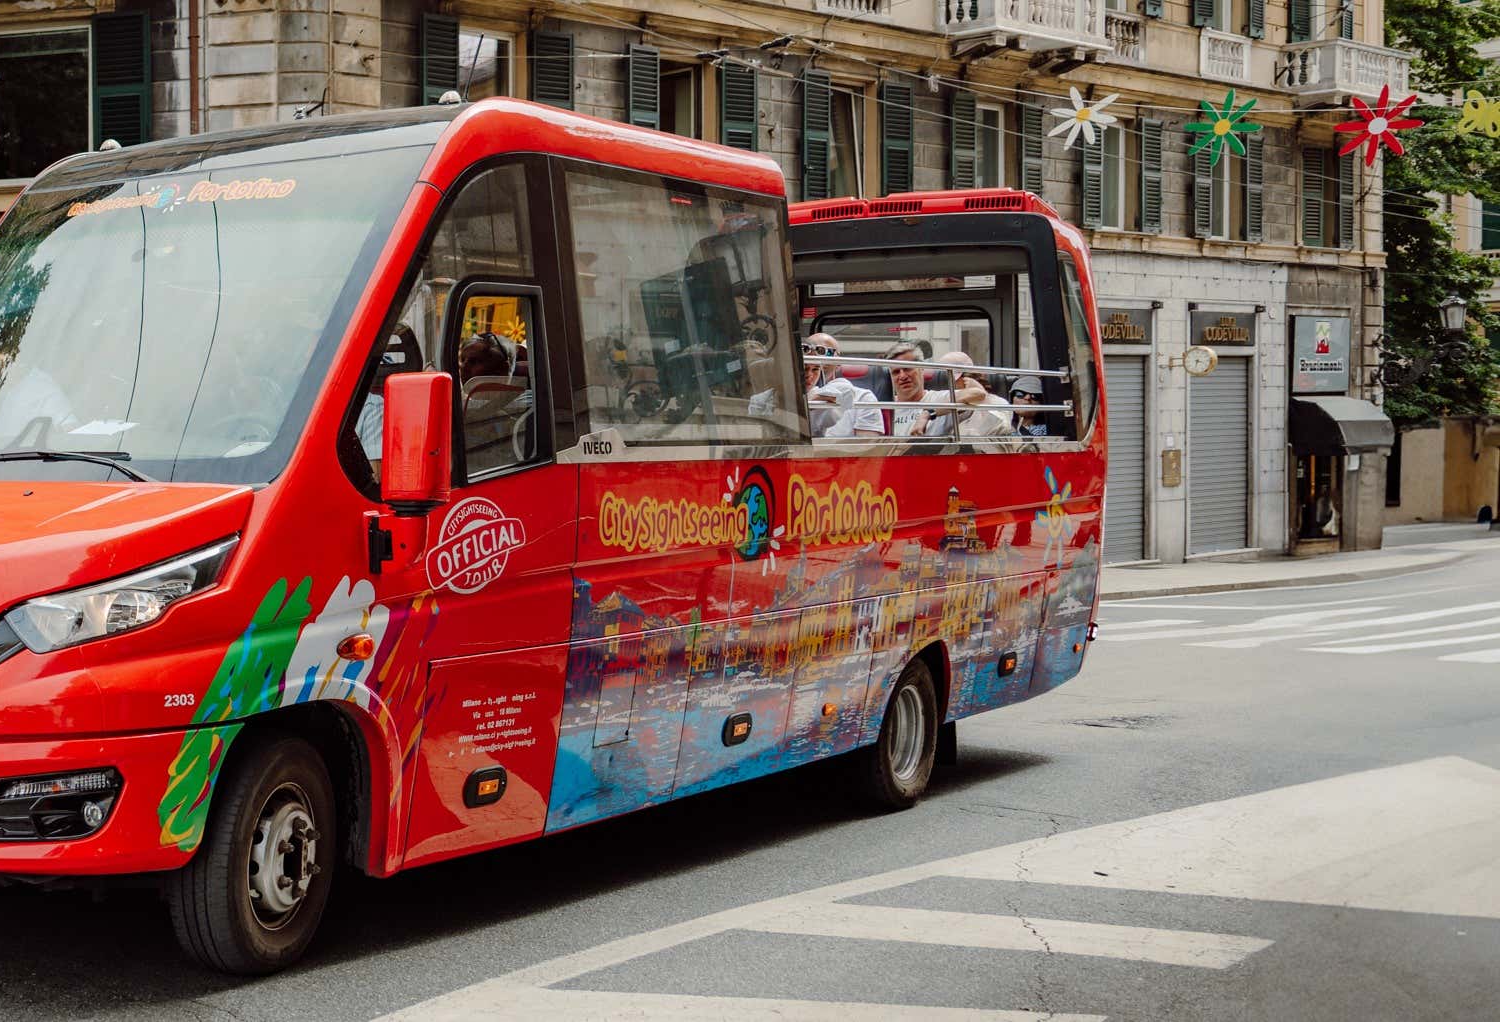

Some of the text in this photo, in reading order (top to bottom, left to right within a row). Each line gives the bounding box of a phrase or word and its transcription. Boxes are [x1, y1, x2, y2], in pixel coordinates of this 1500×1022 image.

[187, 178, 296, 202] Portofino
[1100, 322, 1146, 339] ODEVILLA
[583, 441, 612, 455] IVECO
[447, 503, 498, 536] CITYSIGHTSEEING
[787, 473, 900, 546] Portofino
[437, 522, 520, 578] OFFICIAL
[464, 558, 502, 586] TOUR
[164, 693, 195, 707] 2303
